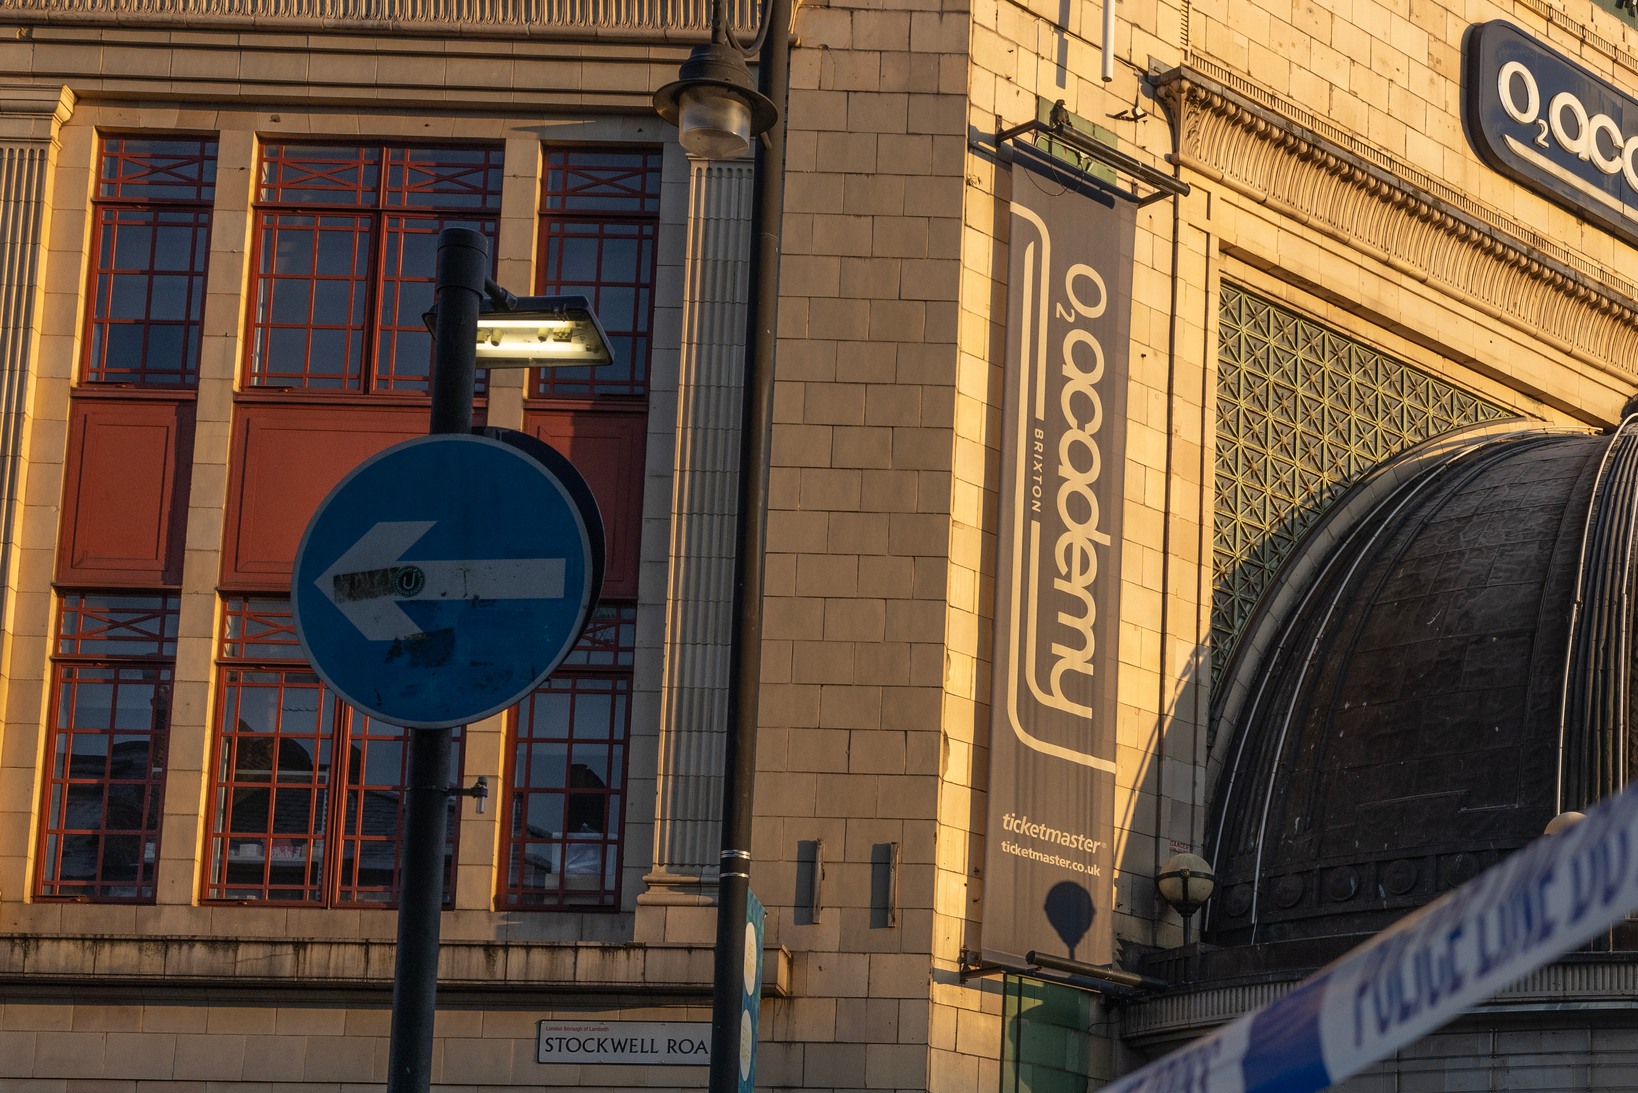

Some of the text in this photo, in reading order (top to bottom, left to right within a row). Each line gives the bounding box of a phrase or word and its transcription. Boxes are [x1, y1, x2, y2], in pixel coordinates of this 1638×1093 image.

[1032, 428, 1045, 513] BRIXTON
[1002, 812, 1101, 854] ticketmaster
[1001, 841, 1101, 877] ticketmaster.co.uk
[545, 1037, 709, 1054] STOCKWELL ROA
